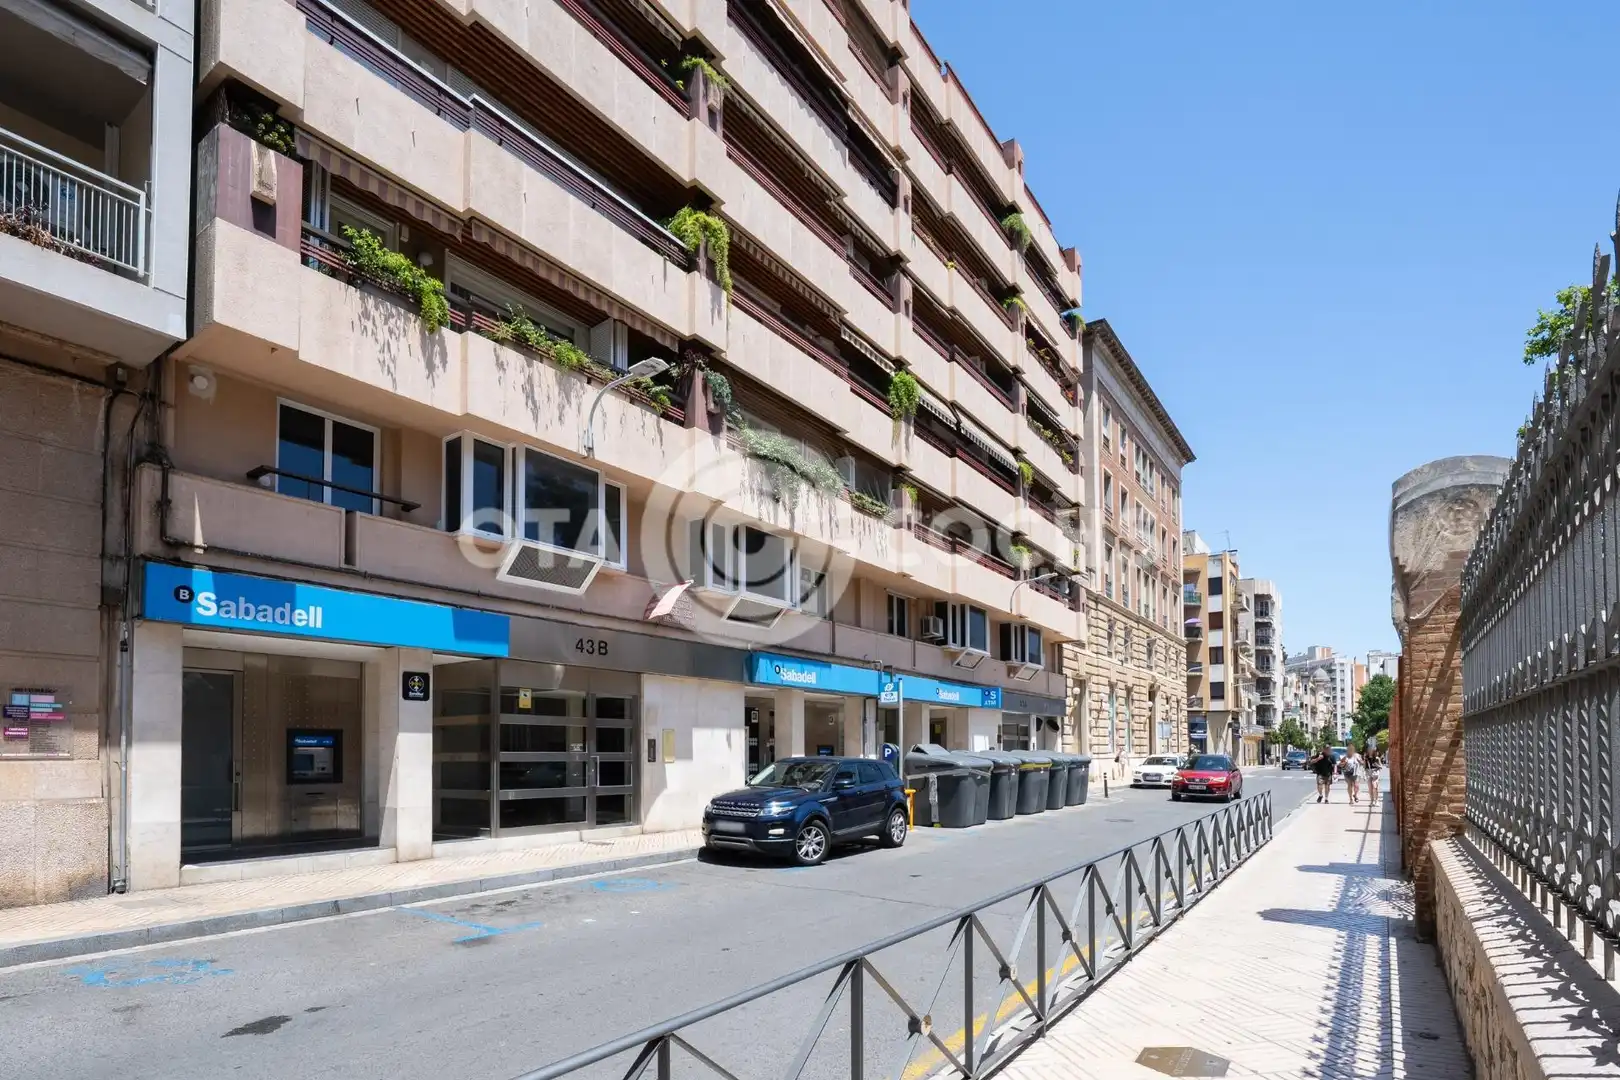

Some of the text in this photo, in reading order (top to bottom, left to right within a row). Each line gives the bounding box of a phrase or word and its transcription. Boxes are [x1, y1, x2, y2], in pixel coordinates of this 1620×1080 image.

[196, 591, 323, 629] Sabadell
[575, 638, 609, 656] 43B
[780, 667, 817, 684] Sabadell
[884, 748, 892, 758] P
